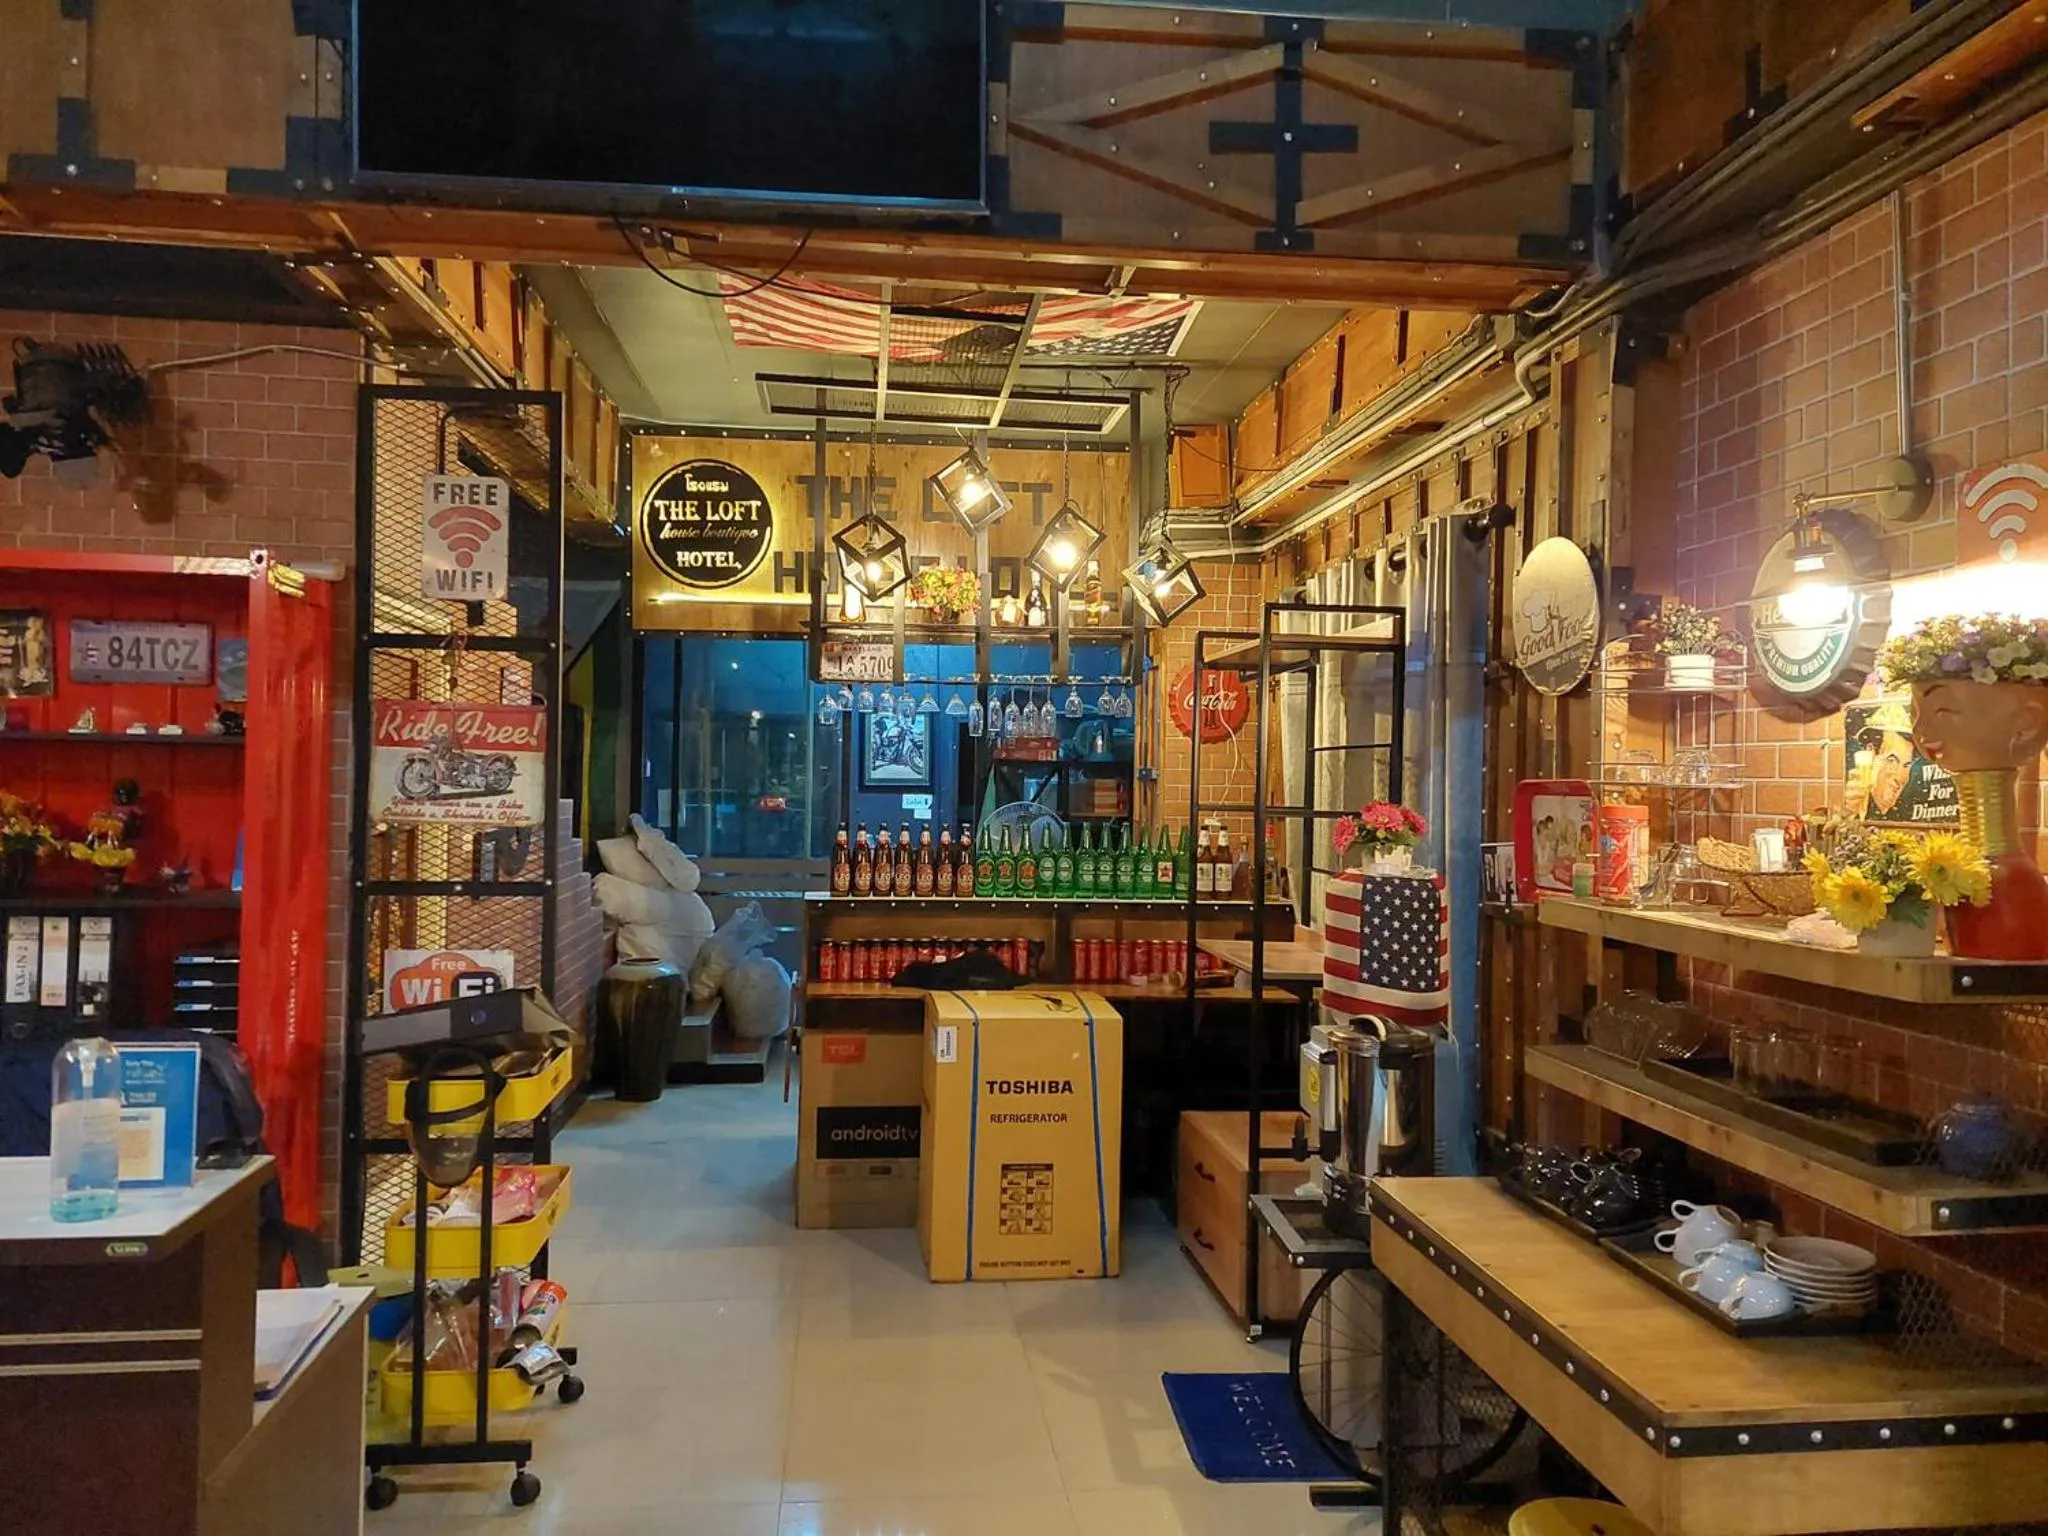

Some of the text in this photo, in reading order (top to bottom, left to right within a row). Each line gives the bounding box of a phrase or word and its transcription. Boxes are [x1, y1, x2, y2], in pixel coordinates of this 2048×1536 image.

[433, 482, 498, 506] FREE
[653, 500, 761, 521] THE LOFT
[660, 522, 758, 544] house boutique
[676, 551, 742, 569] HOTEL
[436, 569, 493, 592] WIFI
[107, 636, 200, 671] 84TCZ
[378, 706, 544, 747] Ride Free!
[431, 957, 467, 970] Free
[828, 1045, 860, 1056] TCL
[986, 1080, 1074, 1095] TOSHIBA
[990, 1113, 1068, 1124] REFRIGERATOR
